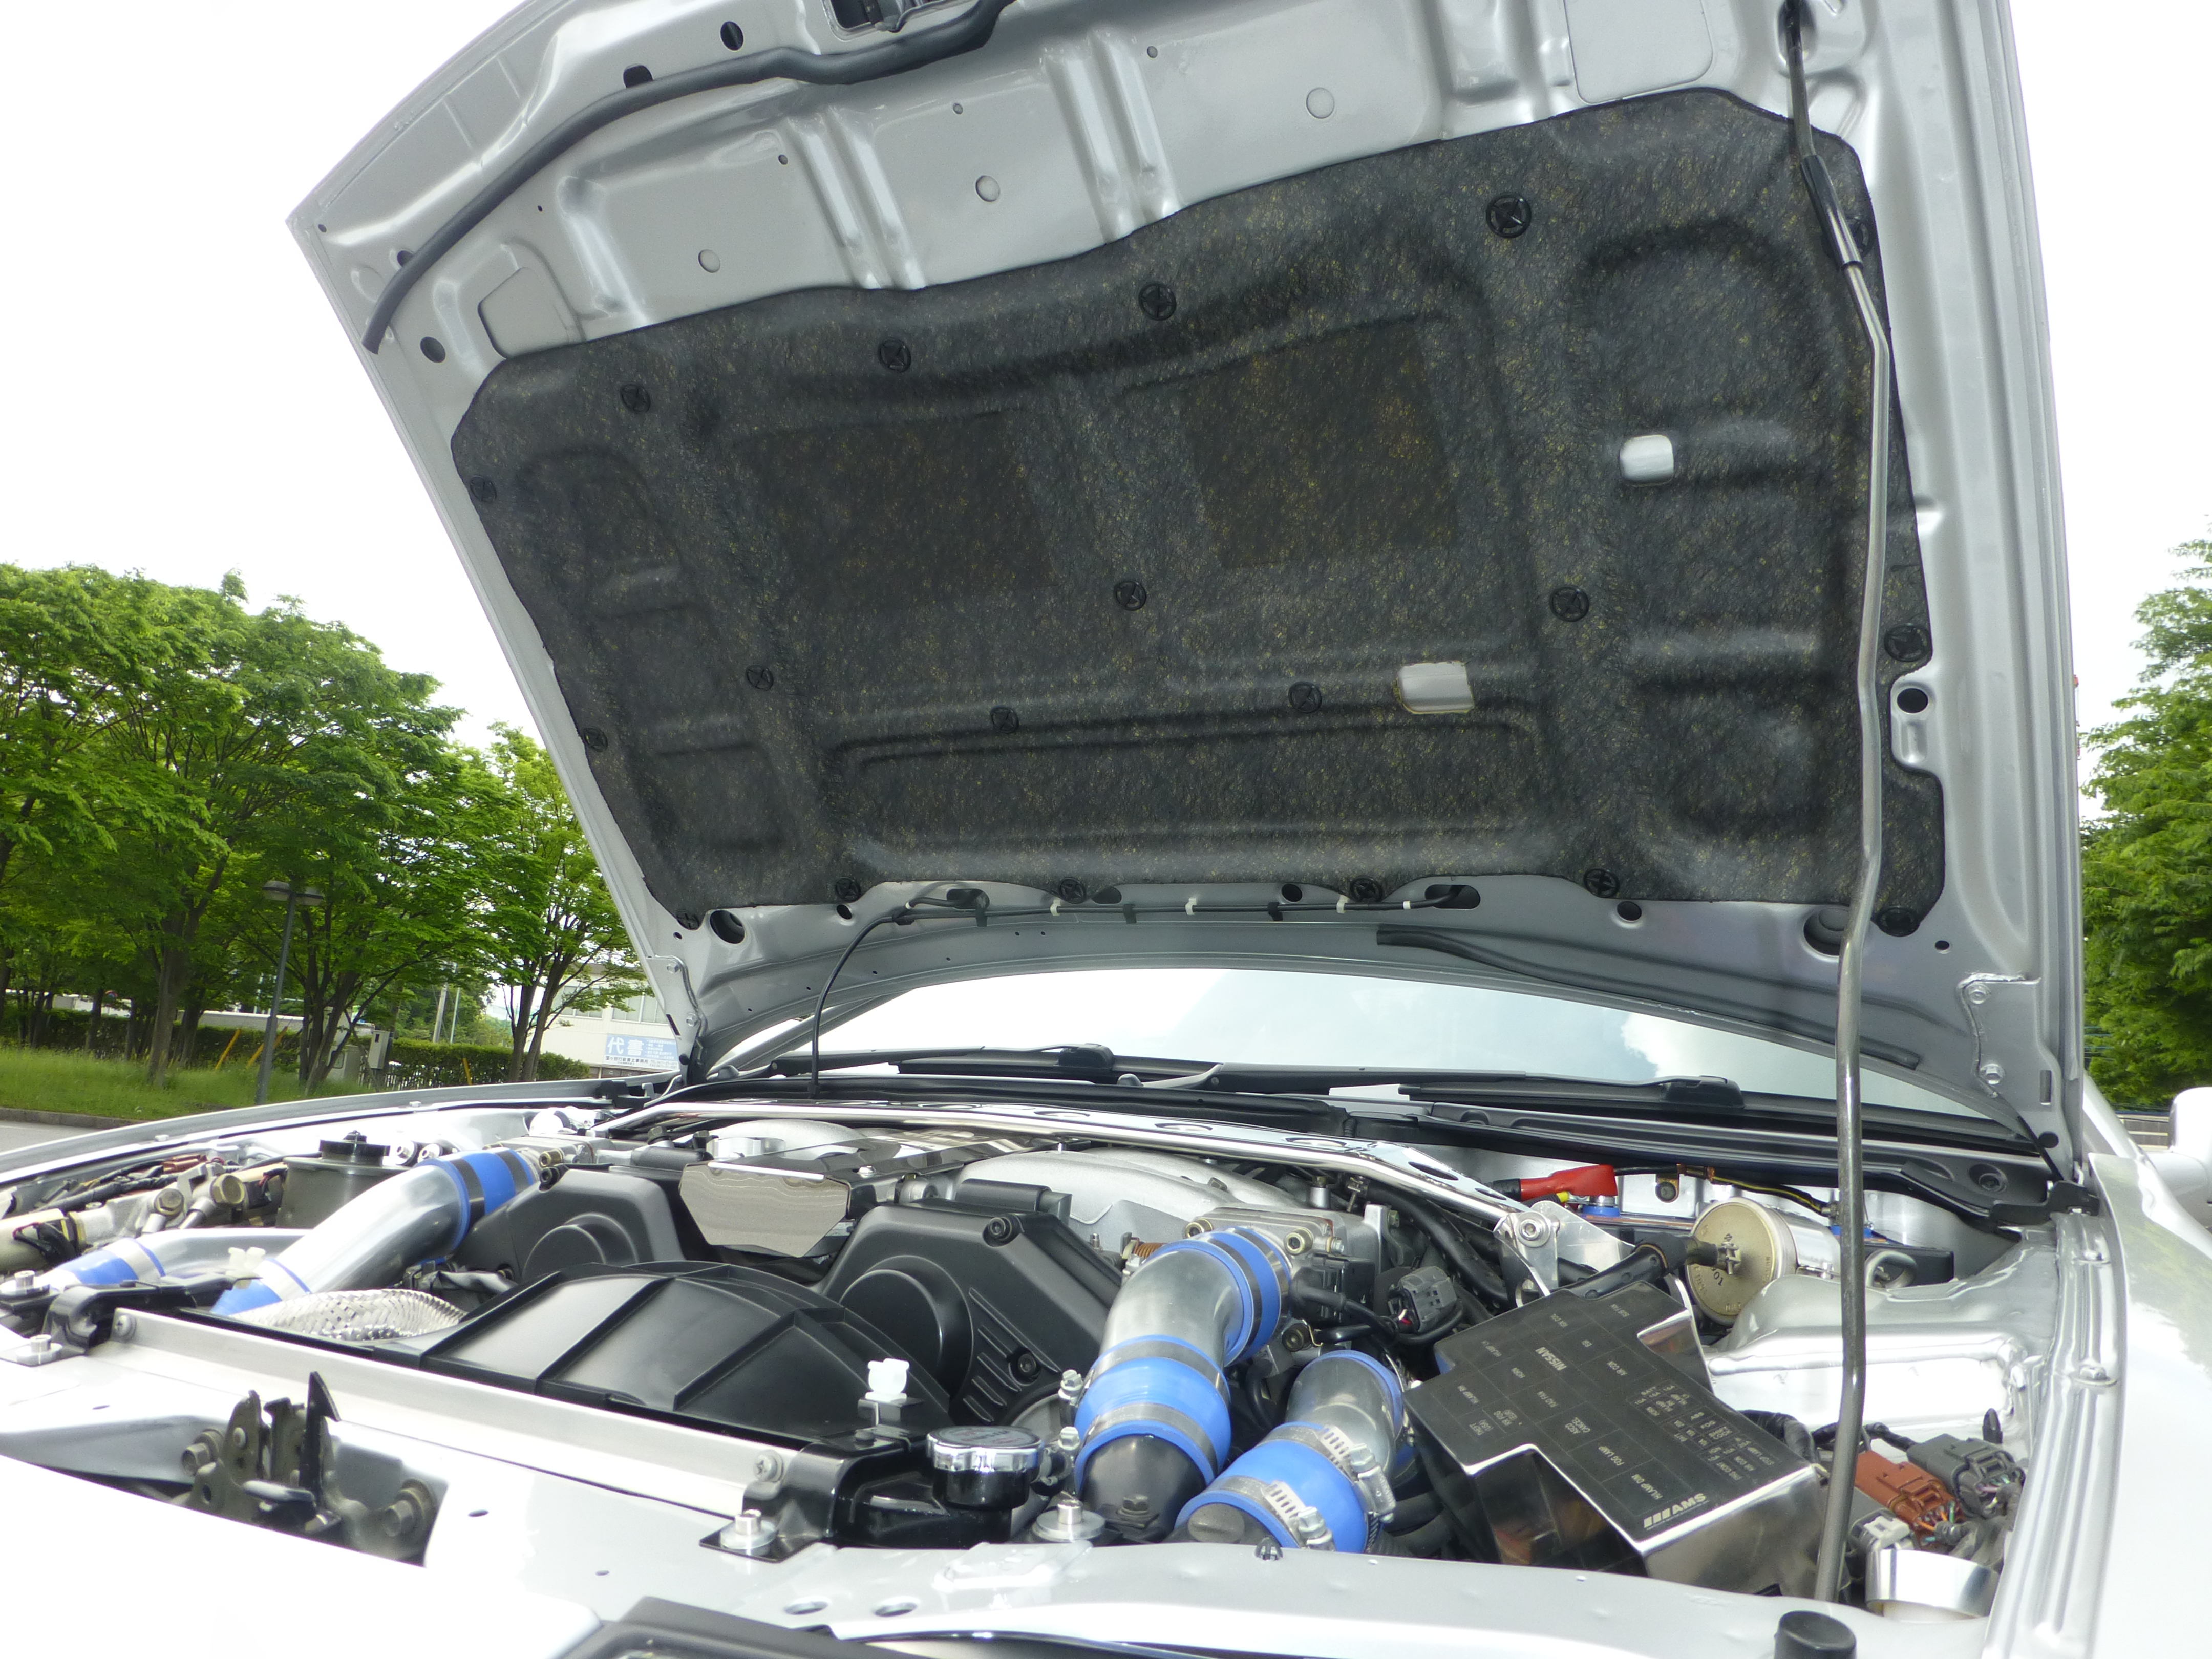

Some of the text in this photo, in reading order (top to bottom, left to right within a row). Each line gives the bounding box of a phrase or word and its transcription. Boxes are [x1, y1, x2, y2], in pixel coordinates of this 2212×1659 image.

[607, 1037, 644, 1056] 代書
[1535, 1347, 1567, 1371] NISSAN
[1607, 1360, 1620, 1370] CON
[1537, 1391, 1549, 1400] FAN
[1469, 1422, 1484, 1436] THEFT
[1479, 1419, 1492, 1431] (USA)
[1571, 1417, 1591, 1433] CANCEL
[1598, 1446, 1625, 1466] FOG LAMP
[1631, 1474, 1645, 1484] DIM
